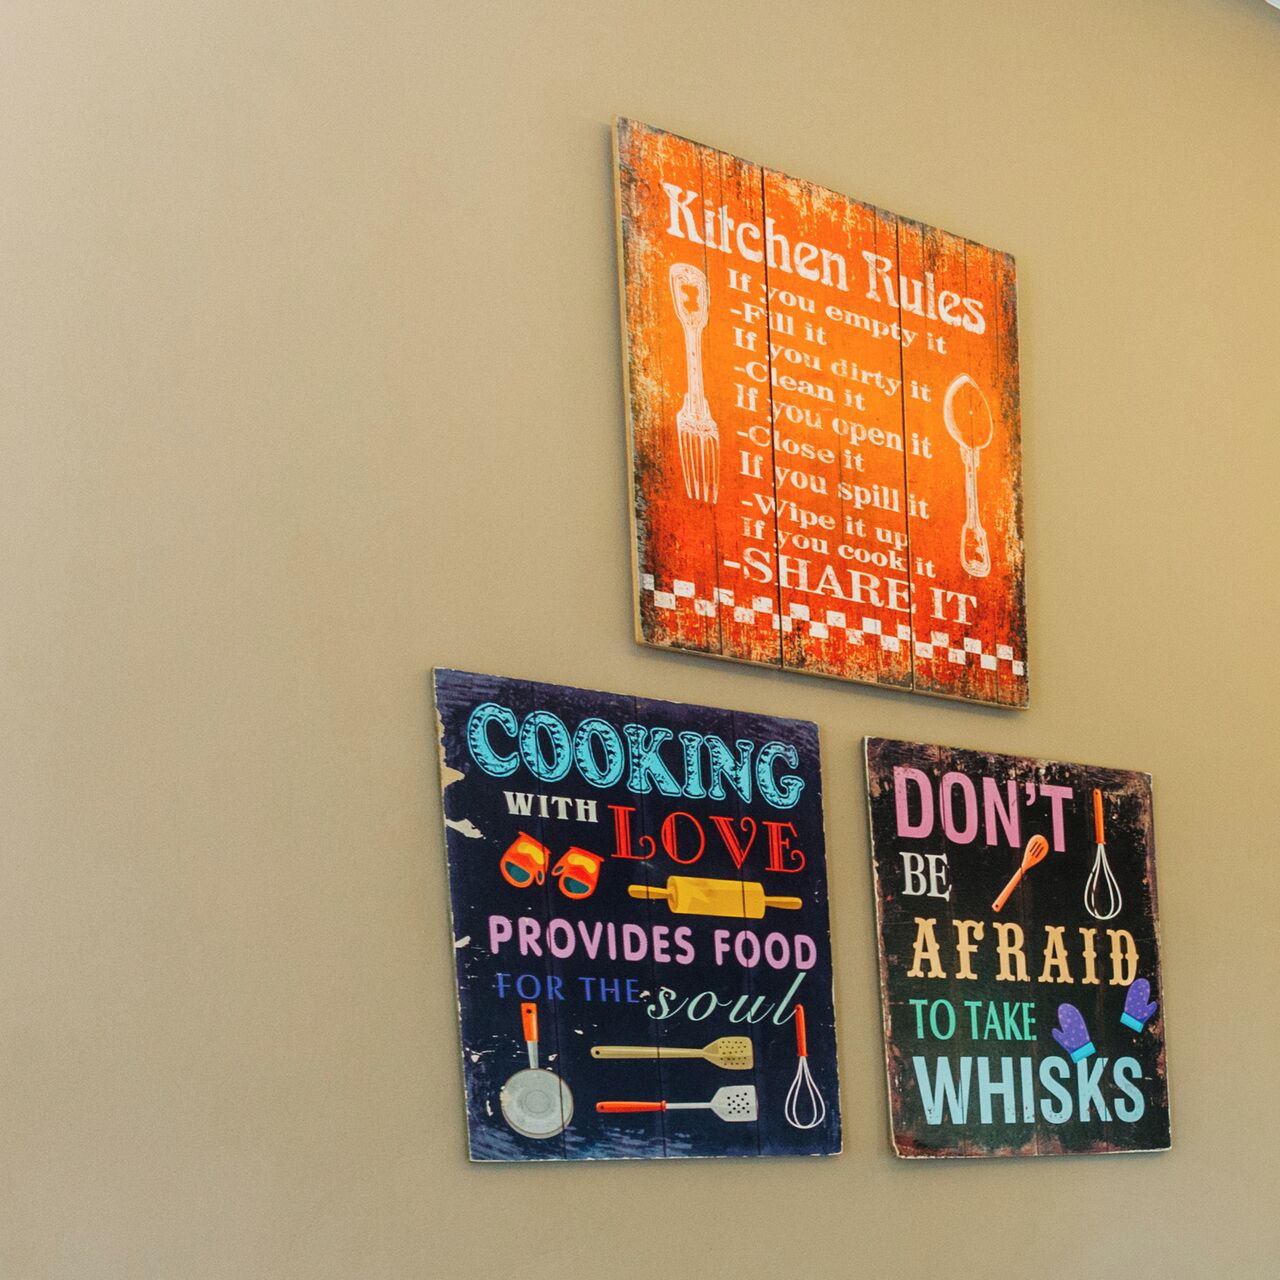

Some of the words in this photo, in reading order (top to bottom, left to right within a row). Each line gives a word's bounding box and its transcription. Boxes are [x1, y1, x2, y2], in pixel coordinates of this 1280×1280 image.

[663, 181, 849, 292] Kitchen
[862, 250, 986, 334] Rules
[727, 268, 752, 293] If
[760, 284, 815, 313] you
[825, 304, 918, 348] empty
[927, 332, 947, 355] it
[730, 303, 795, 336] -Fill
[805, 323, 828, 346] it
[733, 327, 757, 352] If
[766, 341, 822, 372] you
[831, 358, 902, 396] dirty
[911, 380, 932, 403] it
[733, 361, 836, 403] -Clean
[844, 389, 866, 411] it
[734, 384, 758, 412] If
[767, 398, 823, 430] you
[832, 417, 904, 452] open
[911, 433, 933, 459] it
[737, 424, 835, 464] -Close
[844, 449, 865, 472] it
[739, 450, 763, 479] If
[772, 466, 827, 496] you
[837, 480, 900, 513] spill
[908, 494, 930, 520] it
[741, 492, 836, 531] -Wipe
[845, 515, 866, 538] it
[875, 527, 909, 551] up
[741, 516, 766, 541] If
[772, 528, 829, 554] you
[837, 544, 907, 572] cook
[915, 557, 937, 579] it
[723, 547, 917, 614] -SHARE
[929, 587, 978, 626] IT
[467, 702, 806, 810] COOKING
[502, 791, 598, 823] WITH
[607, 804, 806, 874] LOVE
[893, 765, 1074, 853] DON'T
[899, 851, 953, 902] BE
[488, 915, 696, 965] PROVIDES
[714, 929, 818, 970] FOOD
[906, 916, 1140, 986] AFRAID
[496, 972, 566, 1001] FOR
[578, 976, 641, 1004] THE
[646, 972, 806, 1026] soul
[909, 998, 957, 1040] TO
[964, 1000, 1037, 1041] TAKE
[912, 1055, 1146, 1126] WHISKS
